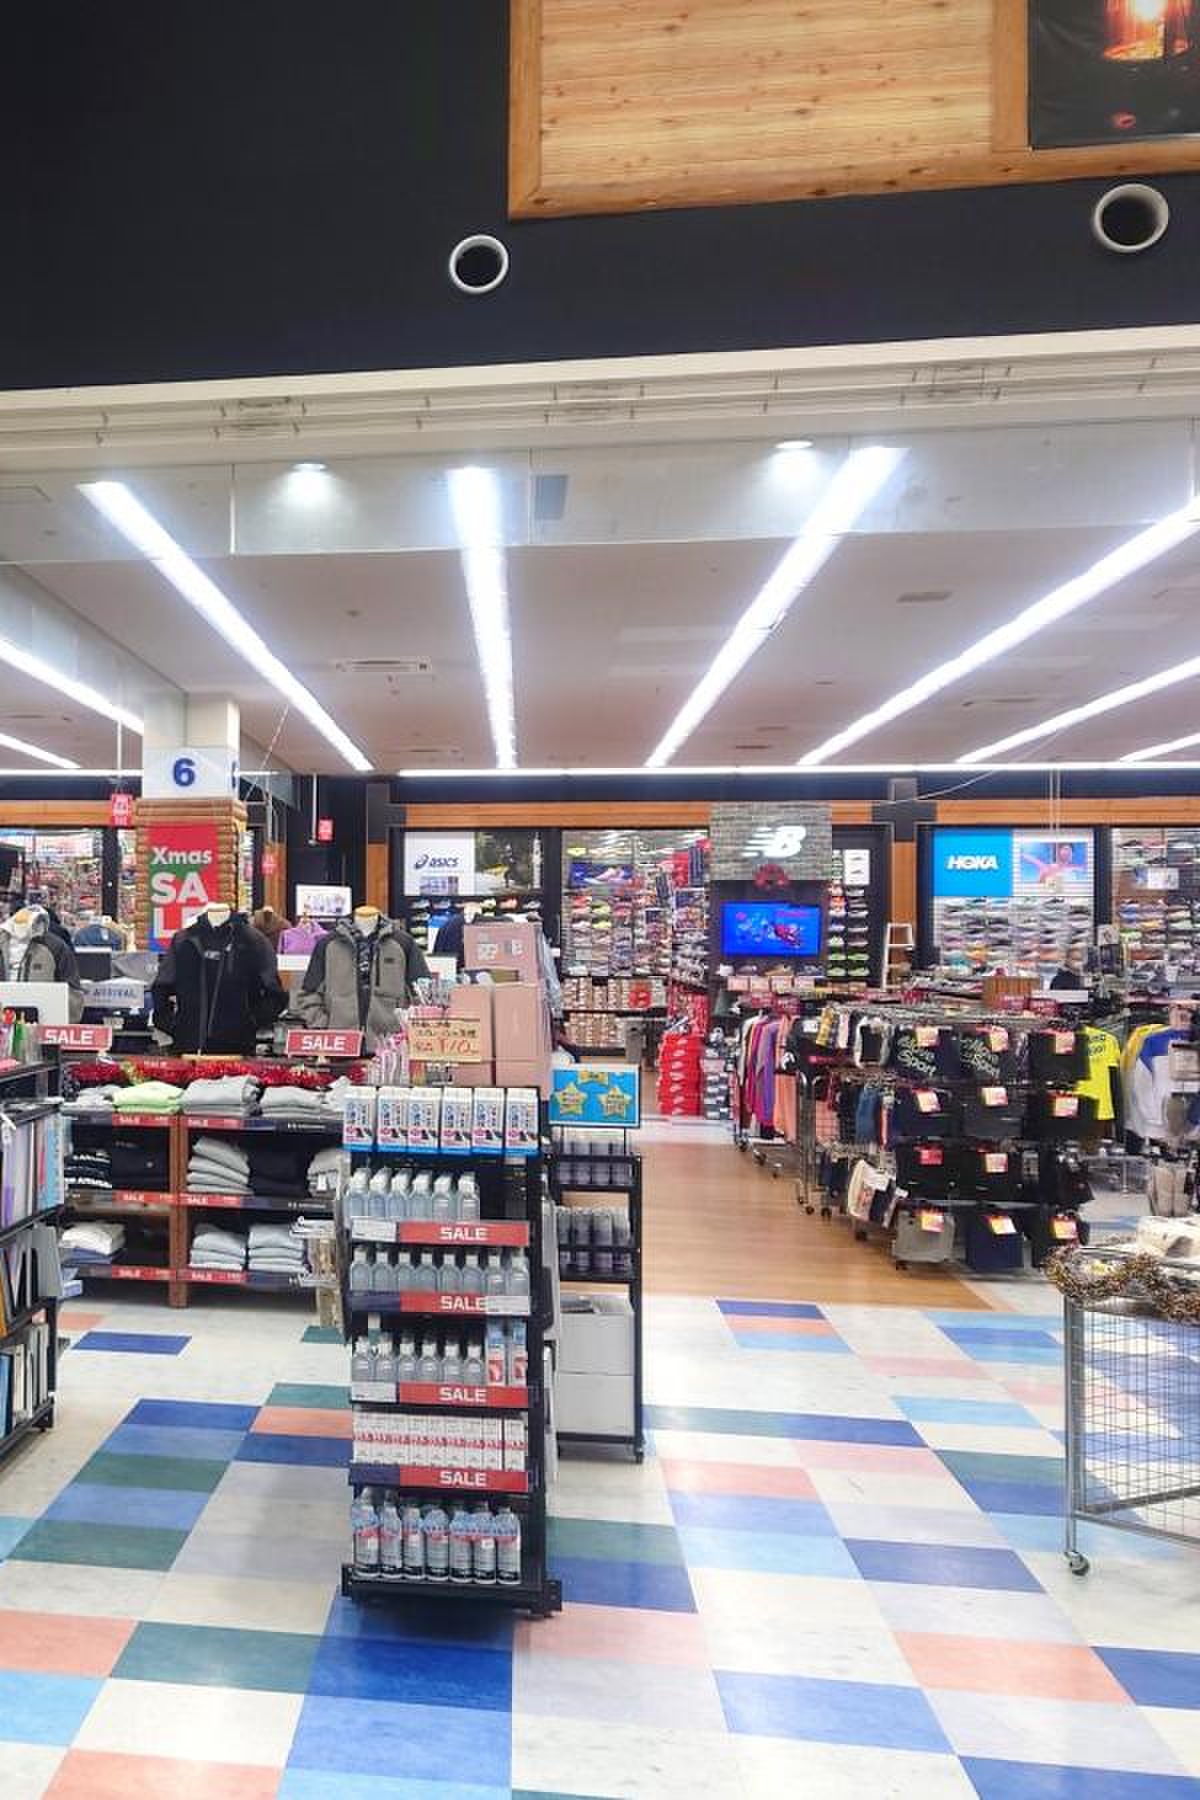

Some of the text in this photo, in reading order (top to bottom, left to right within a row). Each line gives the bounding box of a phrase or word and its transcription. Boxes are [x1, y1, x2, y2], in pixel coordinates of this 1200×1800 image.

[172, 757, 196, 787] 6
[151, 847, 213, 865] Xmas
[945, 855, 999, 870] HOKA
[151, 871, 209, 905] SA
[44, 1028, 95, 1045] SALE
[301, 1035, 346, 1050] SALE
[439, 1227, 488, 1241] SALE
[439, 1296, 487, 1310] SALE
[439, 1387, 487, 1402] SALE
[439, 1471, 487, 1486] SALE
